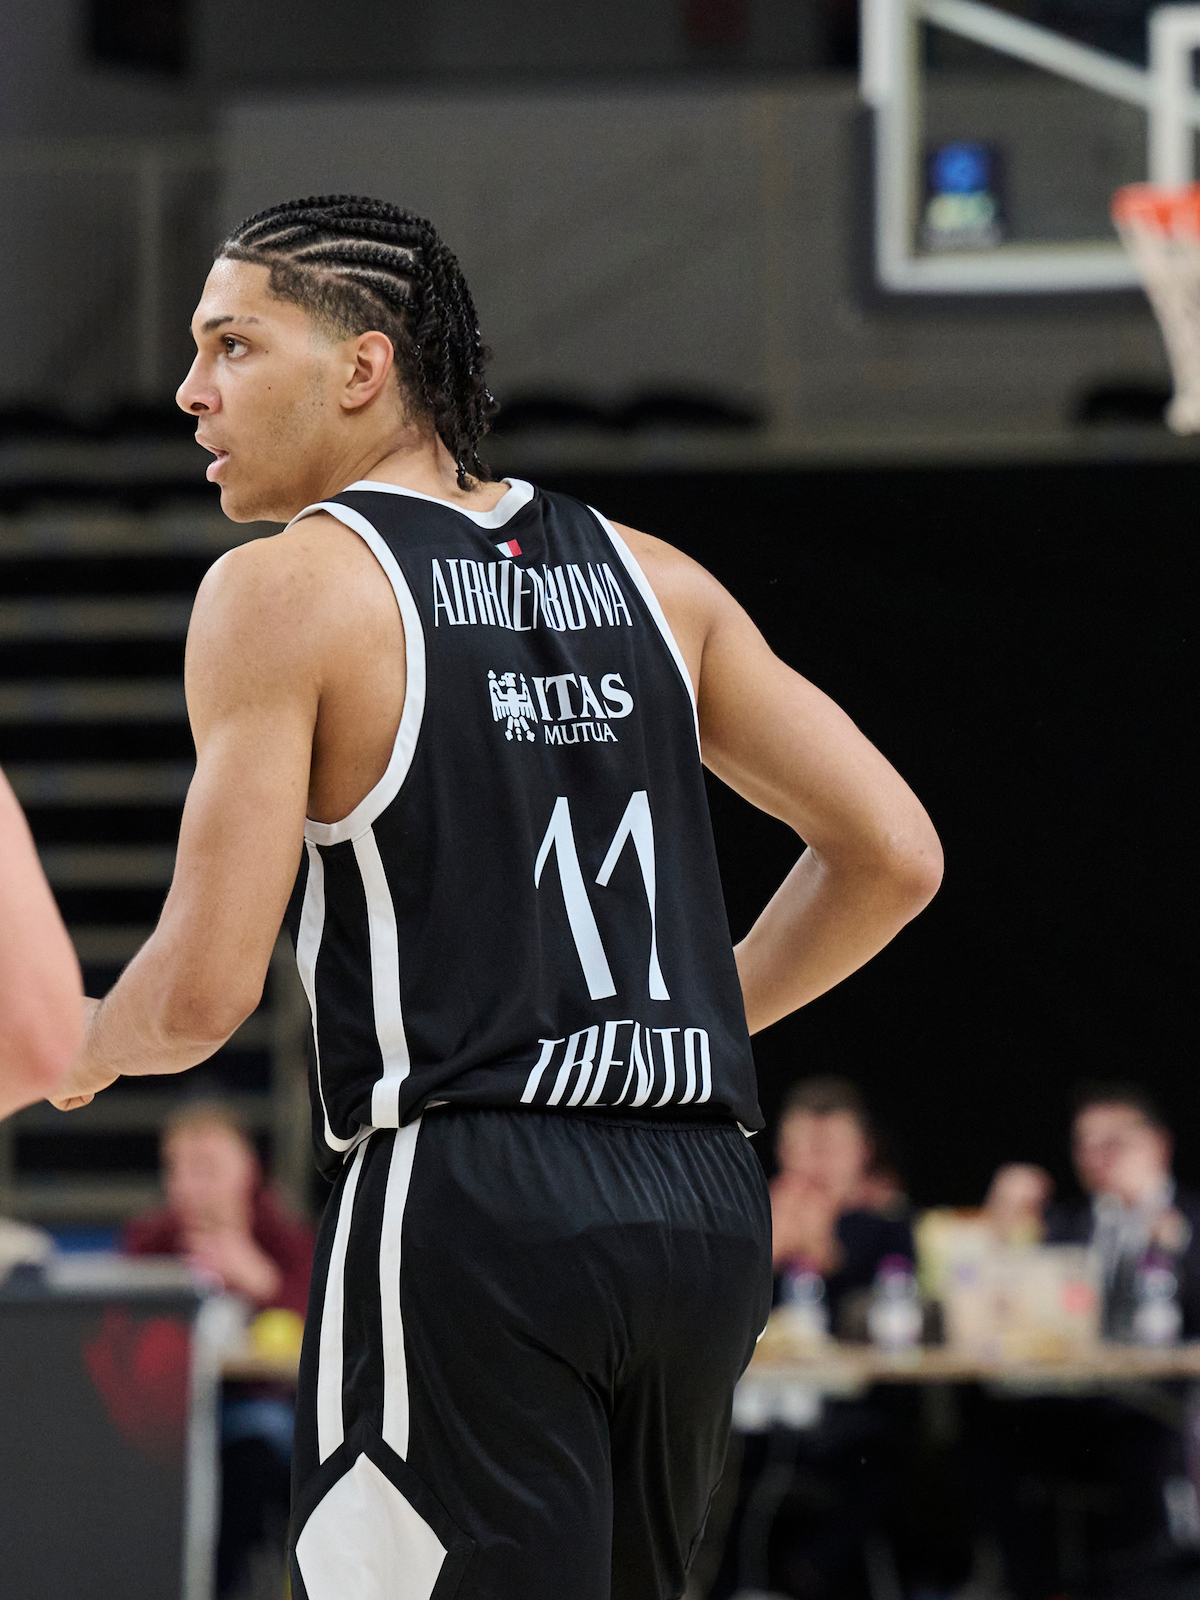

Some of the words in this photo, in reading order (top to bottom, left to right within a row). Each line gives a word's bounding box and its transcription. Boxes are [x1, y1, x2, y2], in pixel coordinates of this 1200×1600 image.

[532, 672, 634, 722] ITAS
[543, 721, 619, 746] MUTUA
[534, 790, 671, 1001] 11
[519, 1019, 713, 1108] TRENTO
